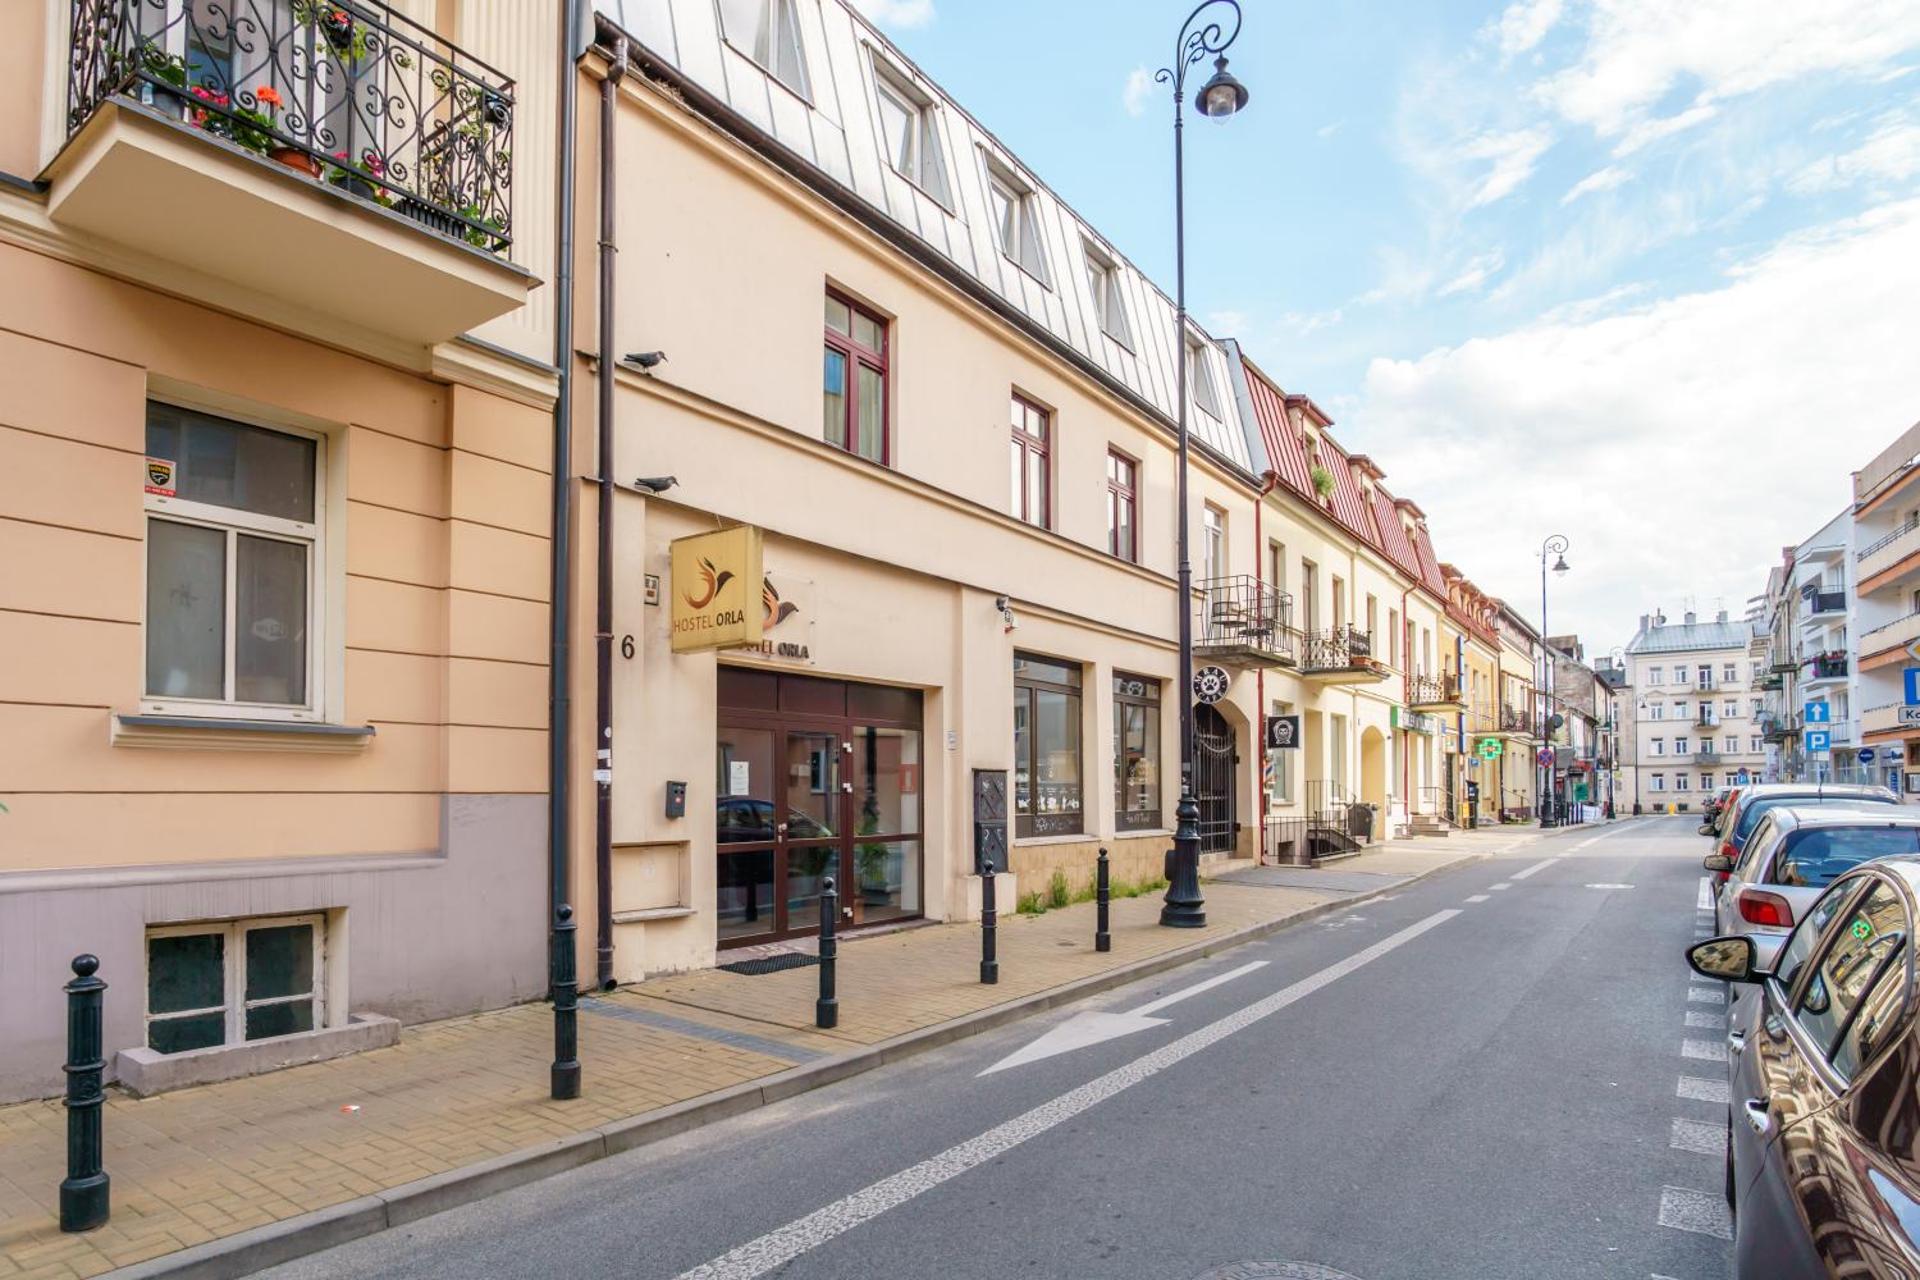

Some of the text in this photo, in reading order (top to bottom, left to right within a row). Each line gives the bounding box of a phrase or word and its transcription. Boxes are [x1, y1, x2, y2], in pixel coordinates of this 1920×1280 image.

[673, 609, 745, 633] HOSTEL ORLA
[621, 634, 635, 660] 6
[777, 641, 809, 659] ORLA
[1811, 734, 1825, 749] P
